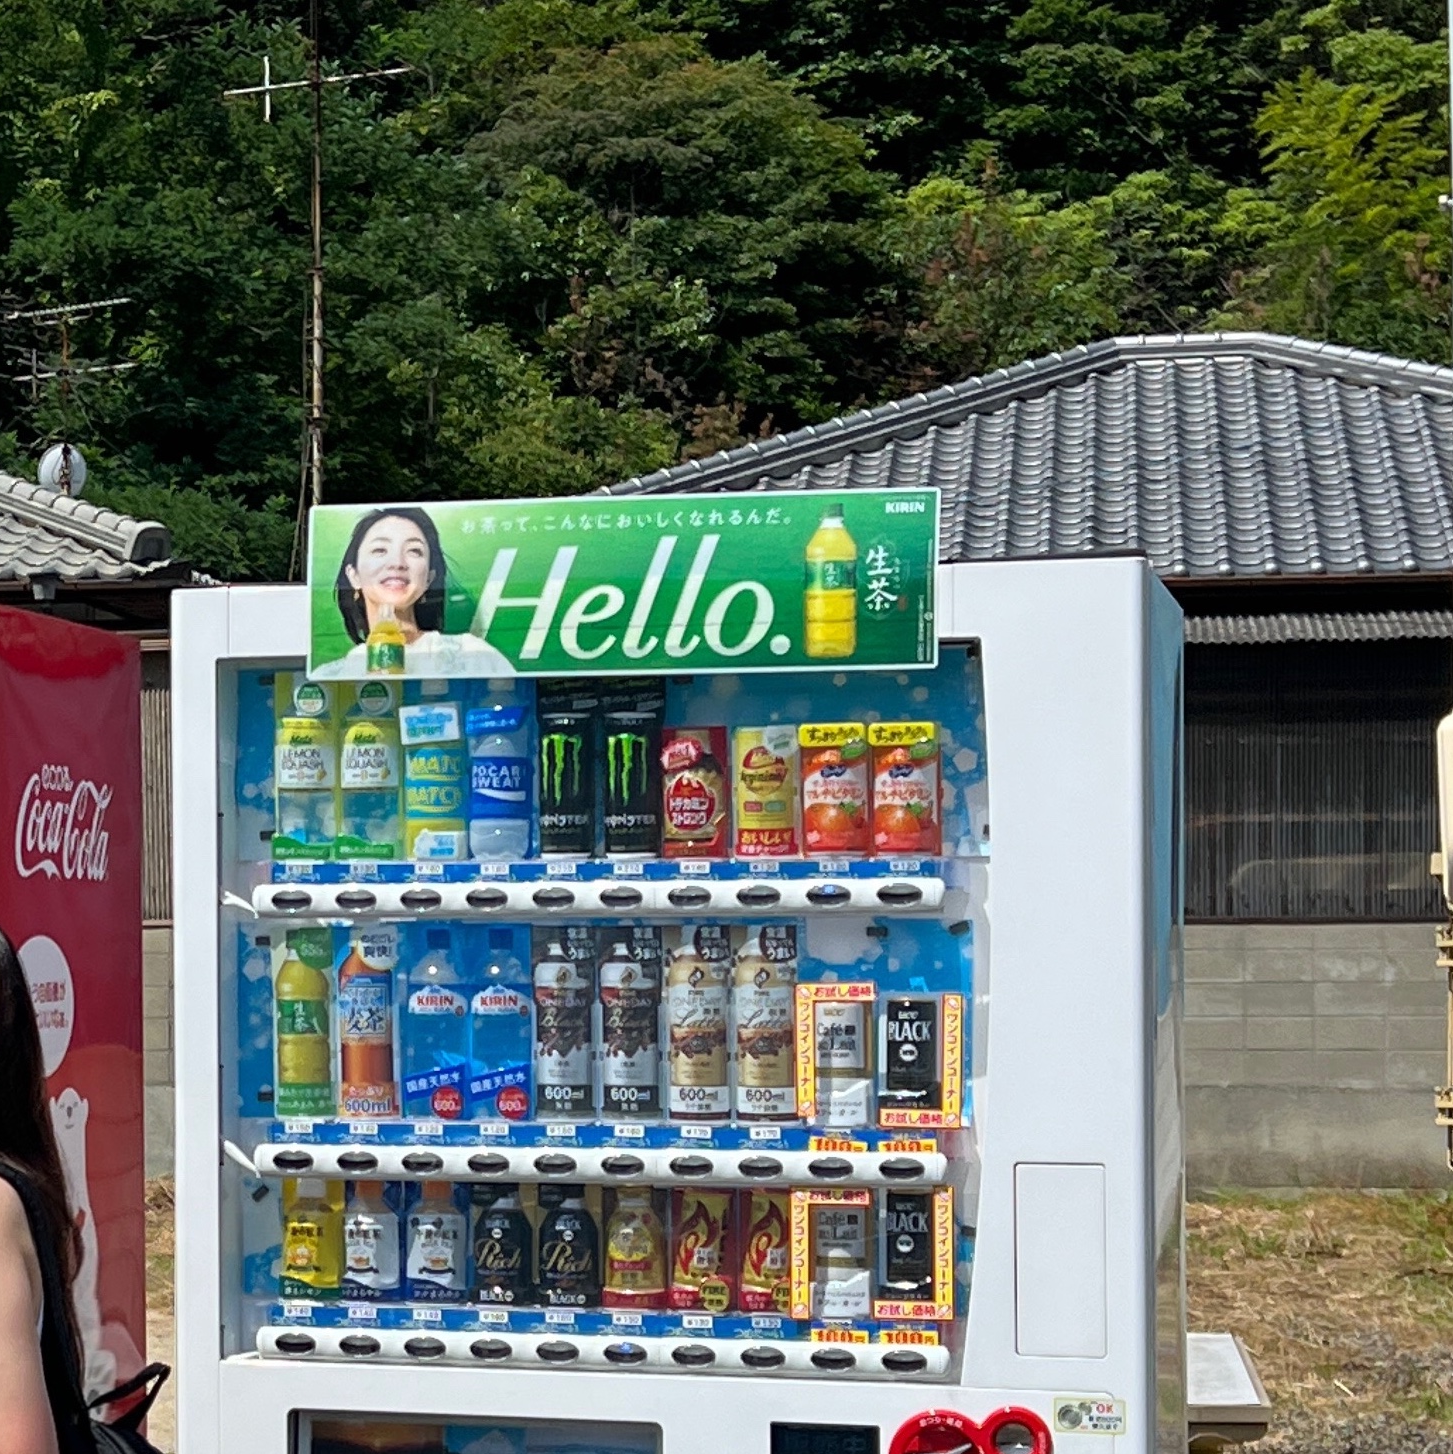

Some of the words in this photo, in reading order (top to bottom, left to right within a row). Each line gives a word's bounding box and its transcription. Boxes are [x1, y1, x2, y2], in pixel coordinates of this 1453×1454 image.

[886, 502, 925, 513] KIRIN
[865, 545, 898, 611] 生茶
[468, 534, 791, 660] Hello.
[15, 772, 113, 881] Coca-Cola
[416, 995, 454, 1006] KIRIN
[480, 995, 518, 1006] KIRIN
[814, 986, 872, 998] お試し価格
[888, 1020, 931, 1041] BLACK
[799, 1001, 811, 1098] ワンコインコーナー
[946, 1013, 958, 1109] ワンコインコーナー
[884, 1112, 943, 1125] お試し価格
[474, 1238, 522, 1269] Rich
[542, 1241, 592, 1272] Rich
[793, 1203, 805, 1300] ワンコインコーナー
[938, 1203, 949, 1301] ワンコインコーナー
[877, 1305, 937, 1317] お試し価格
[1096, 1403, 1114, 1414] OK
